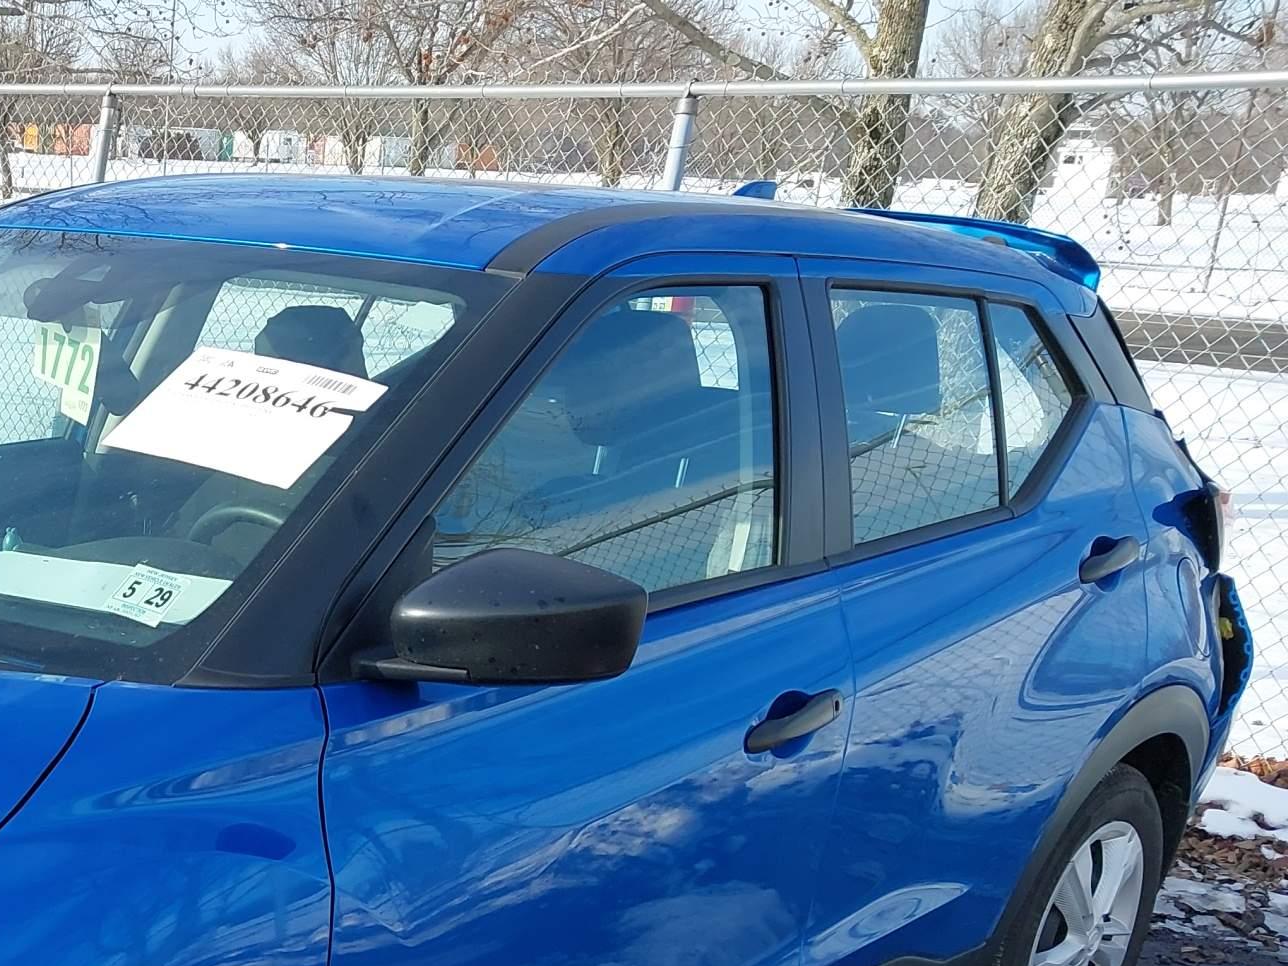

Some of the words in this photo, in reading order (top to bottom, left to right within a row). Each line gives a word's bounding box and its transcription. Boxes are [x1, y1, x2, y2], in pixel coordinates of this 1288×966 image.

[40, 326, 94, 395] 1772
[184, 373, 336, 418] 44208646
[122, 580, 142, 598] 5
[144, 587, 173, 608] 29
